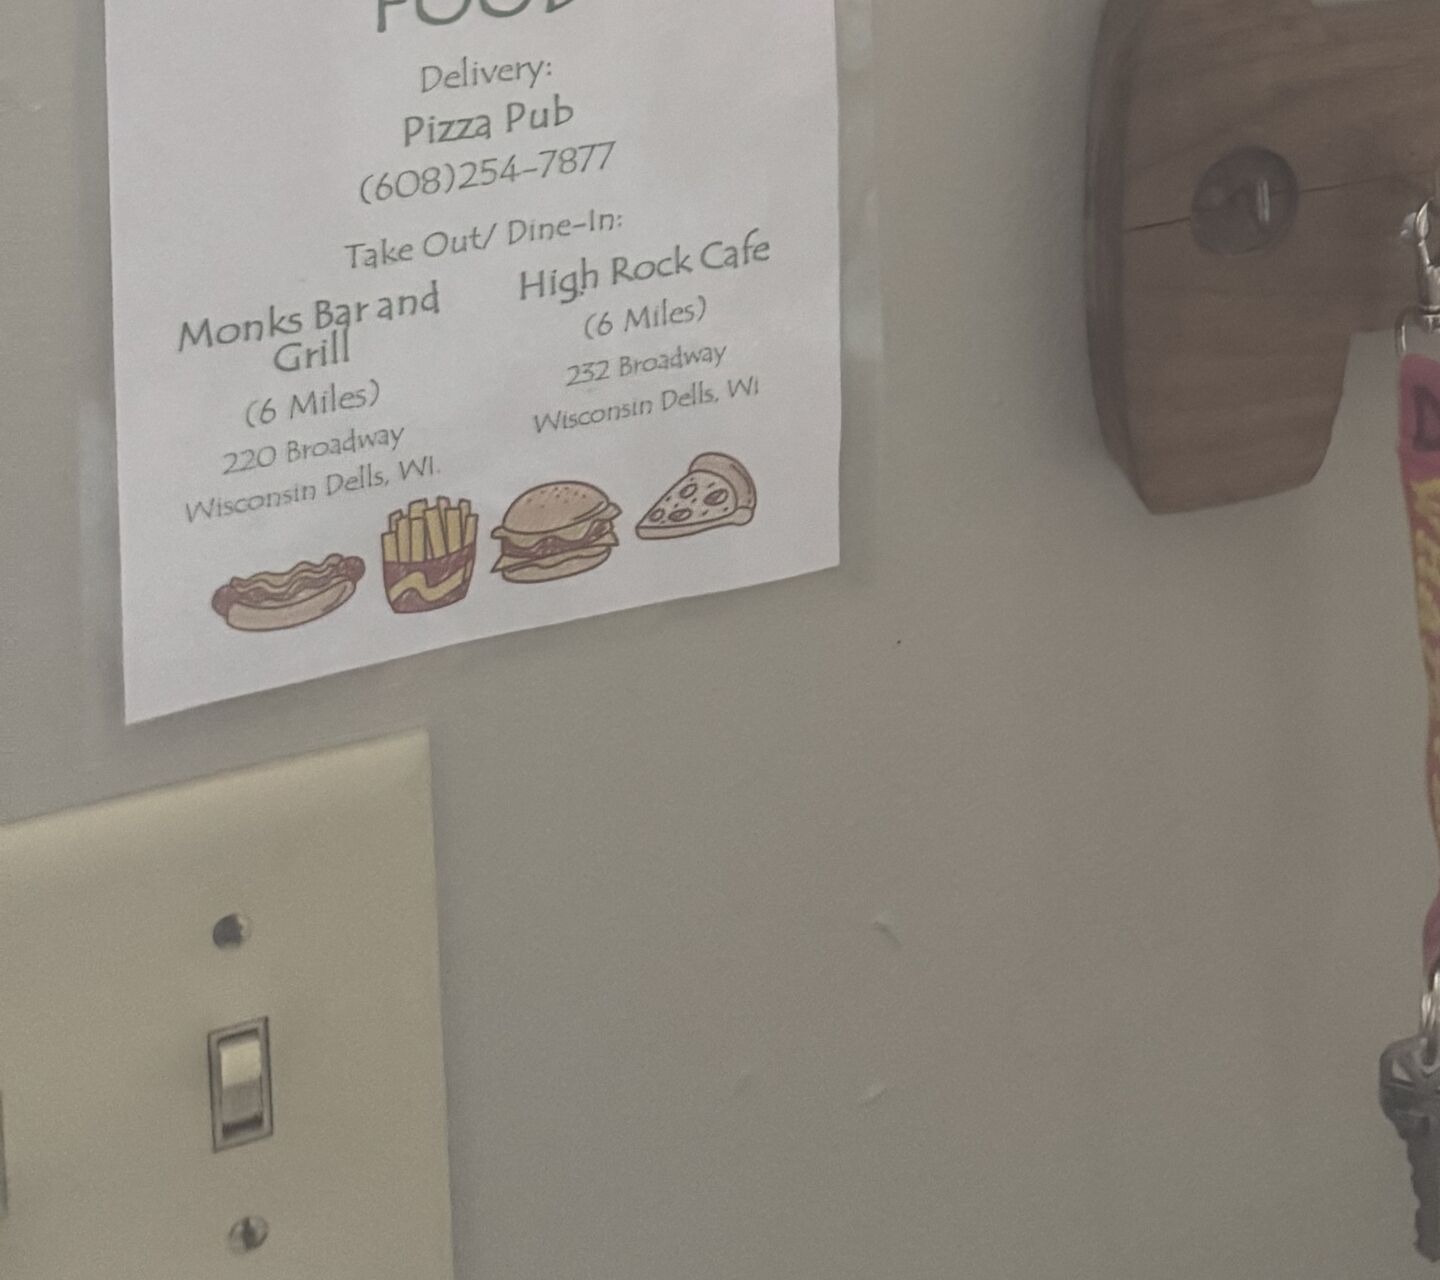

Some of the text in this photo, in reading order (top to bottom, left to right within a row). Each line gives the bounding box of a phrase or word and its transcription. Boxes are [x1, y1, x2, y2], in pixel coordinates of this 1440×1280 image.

[420, 56, 553, 94] Delivery:
[402, 93, 574, 148] Pizza Pub
[359, 140, 617, 205] (608)254-7877
[344, 208, 624, 270] Take Out/ Dine-In:
[519, 227, 771, 304] High Rock Cafe
[178, 280, 440, 352] Monks Bar and
[584, 295, 707, 340] (6 Miles)
[273, 328, 350, 372] Grill
[566, 345, 727, 387] 232 Broadway
[245, 378, 380, 428] (6 Miles)
[533, 399, 653, 434] Wisconsin
[727, 375, 759, 397] WI
[222, 427, 405, 475] 220 Broadway
[186, 486, 316, 523] Wisconsin
[326, 464, 390, 496] Dells,
